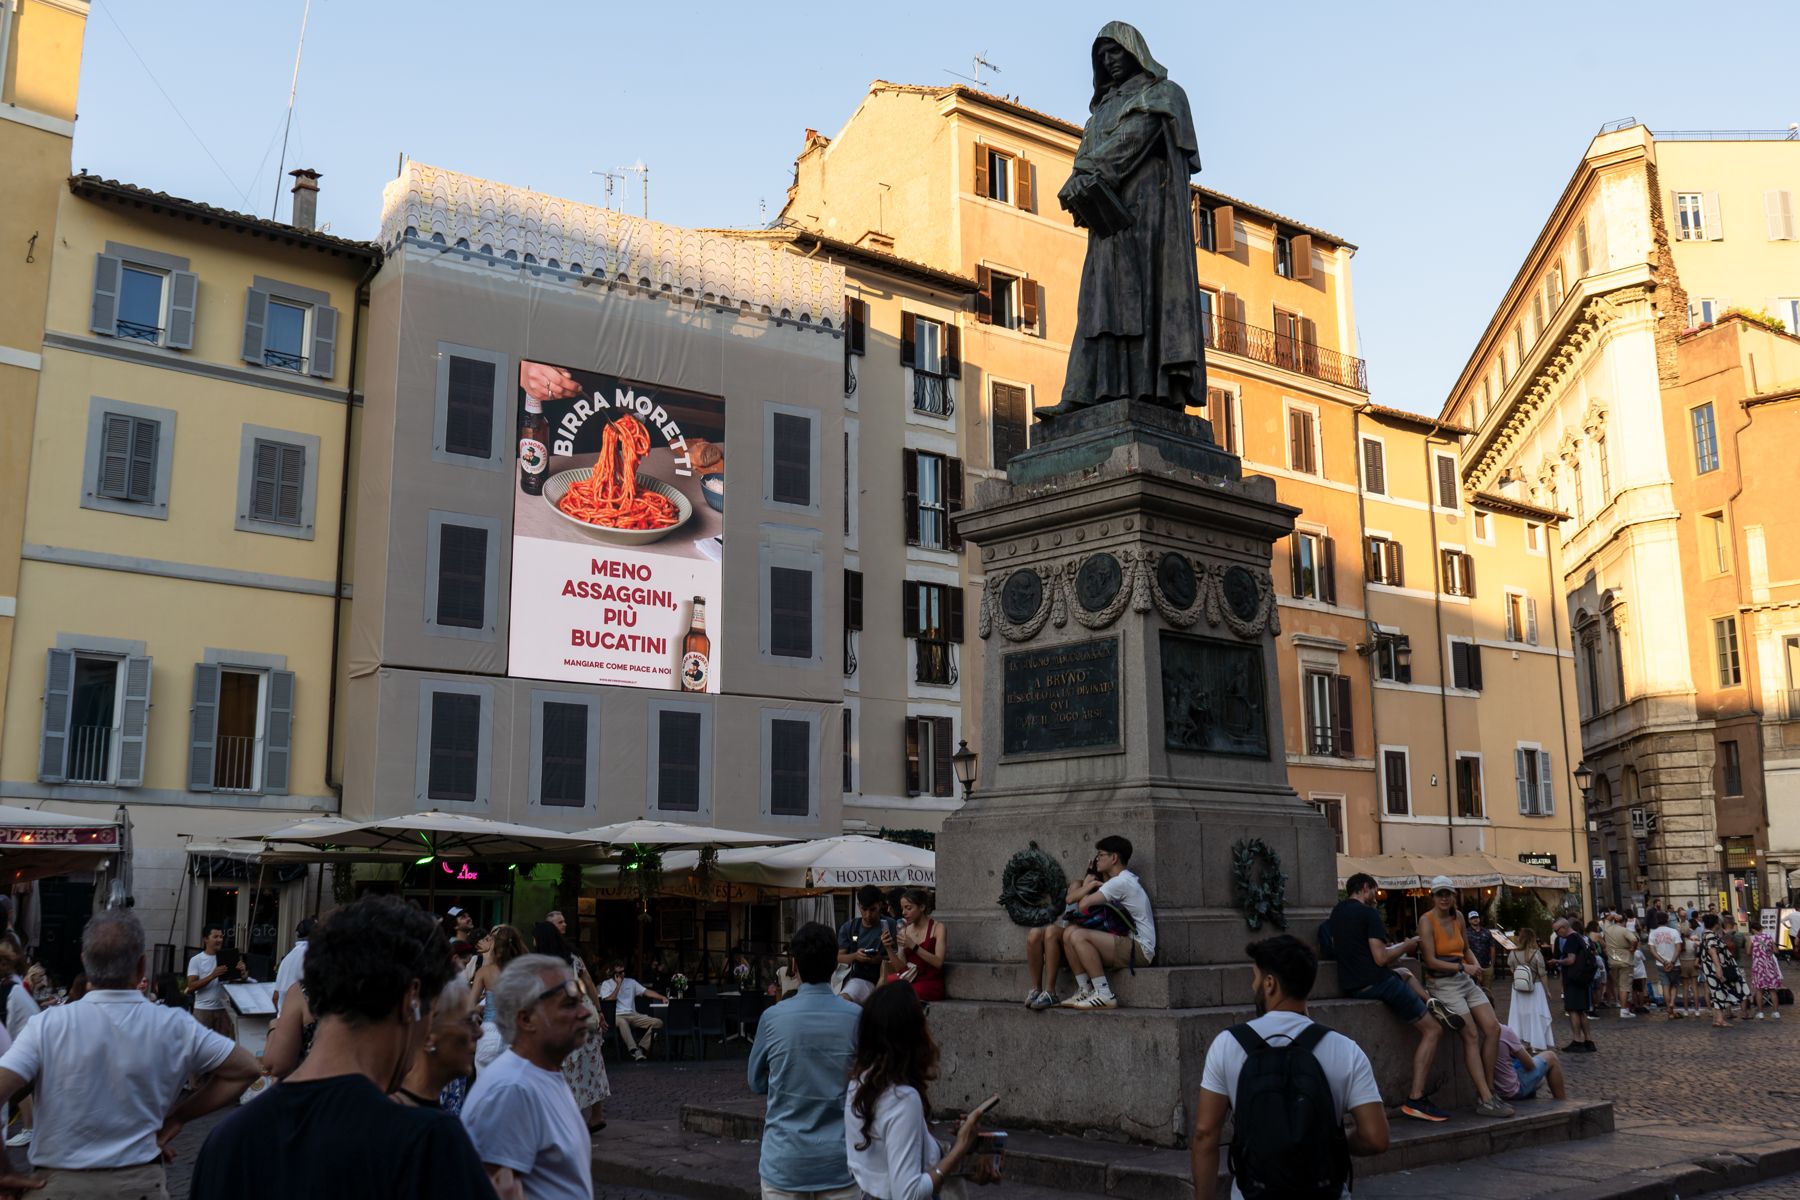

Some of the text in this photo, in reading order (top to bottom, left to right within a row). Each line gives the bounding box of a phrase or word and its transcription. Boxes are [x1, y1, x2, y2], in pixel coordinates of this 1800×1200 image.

[553, 388, 693, 477] BIRRA MORETTI
[591, 558, 652, 582] MENO
[561, 579, 678, 612] ASSAGGINI,
[603, 604, 637, 628] PIÙ
[571, 629, 667, 655] BUCATINI
[563, 659, 605, 669] MANGIARE
[606, 662, 628, 671] COME
[629, 665, 651, 673] PIACE
[658, 667, 672, 675] NOI
[0, 828, 77, 843] PIZZERIA
[1532, 857, 1551, 865] GELATERIA
[836, 869, 936, 883] HOSTARIA ROM
